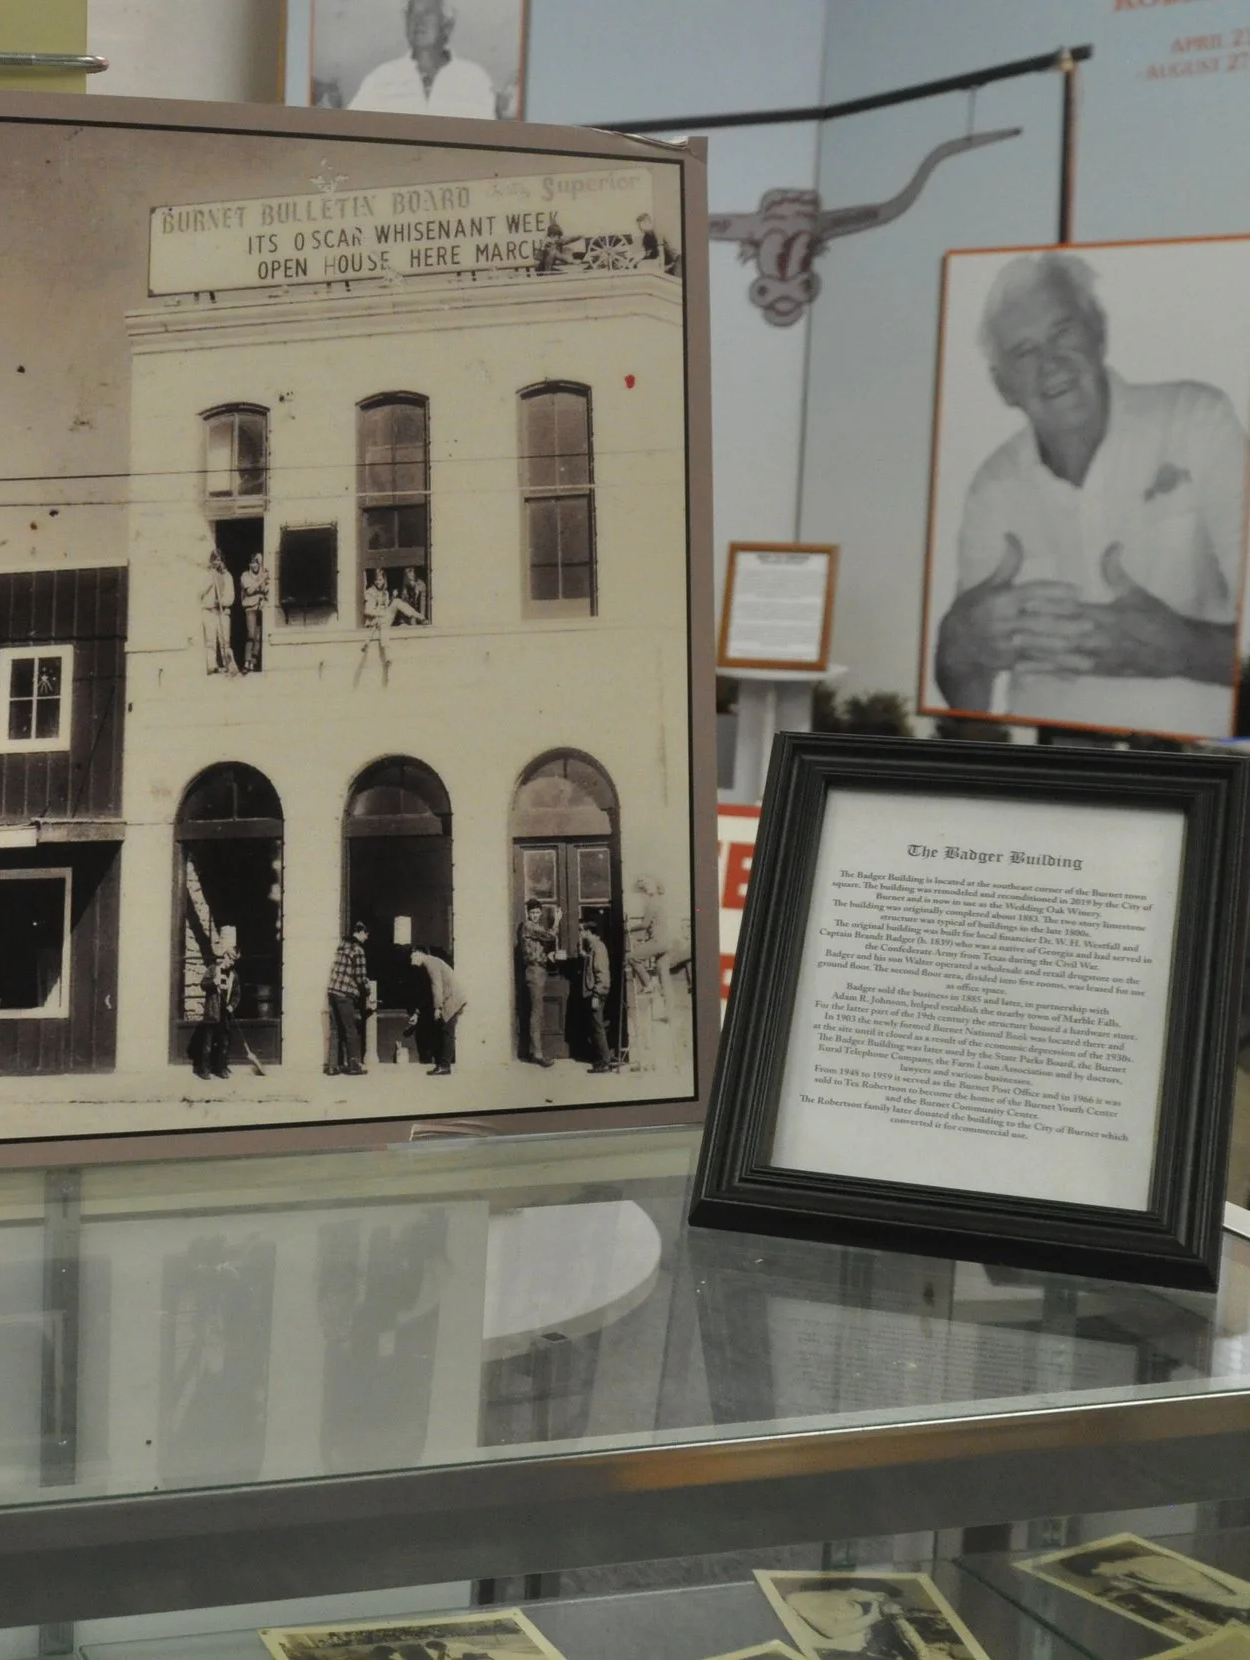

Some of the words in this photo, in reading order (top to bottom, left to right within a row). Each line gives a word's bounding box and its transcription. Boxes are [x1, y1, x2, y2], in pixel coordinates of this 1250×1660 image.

[162, 206, 247, 234] BURNET
[260, 195, 376, 226] BULLETIN
[248, 234, 278, 255] ITS
[374, 216, 496, 245] WHISENANT
[258, 257, 308, 280] OPEN
[410, 245, 461, 268] HERE
[907, 844, 938, 858] The
[944, 846, 1002, 864] Badger
[1010, 851, 1082, 871] Building
